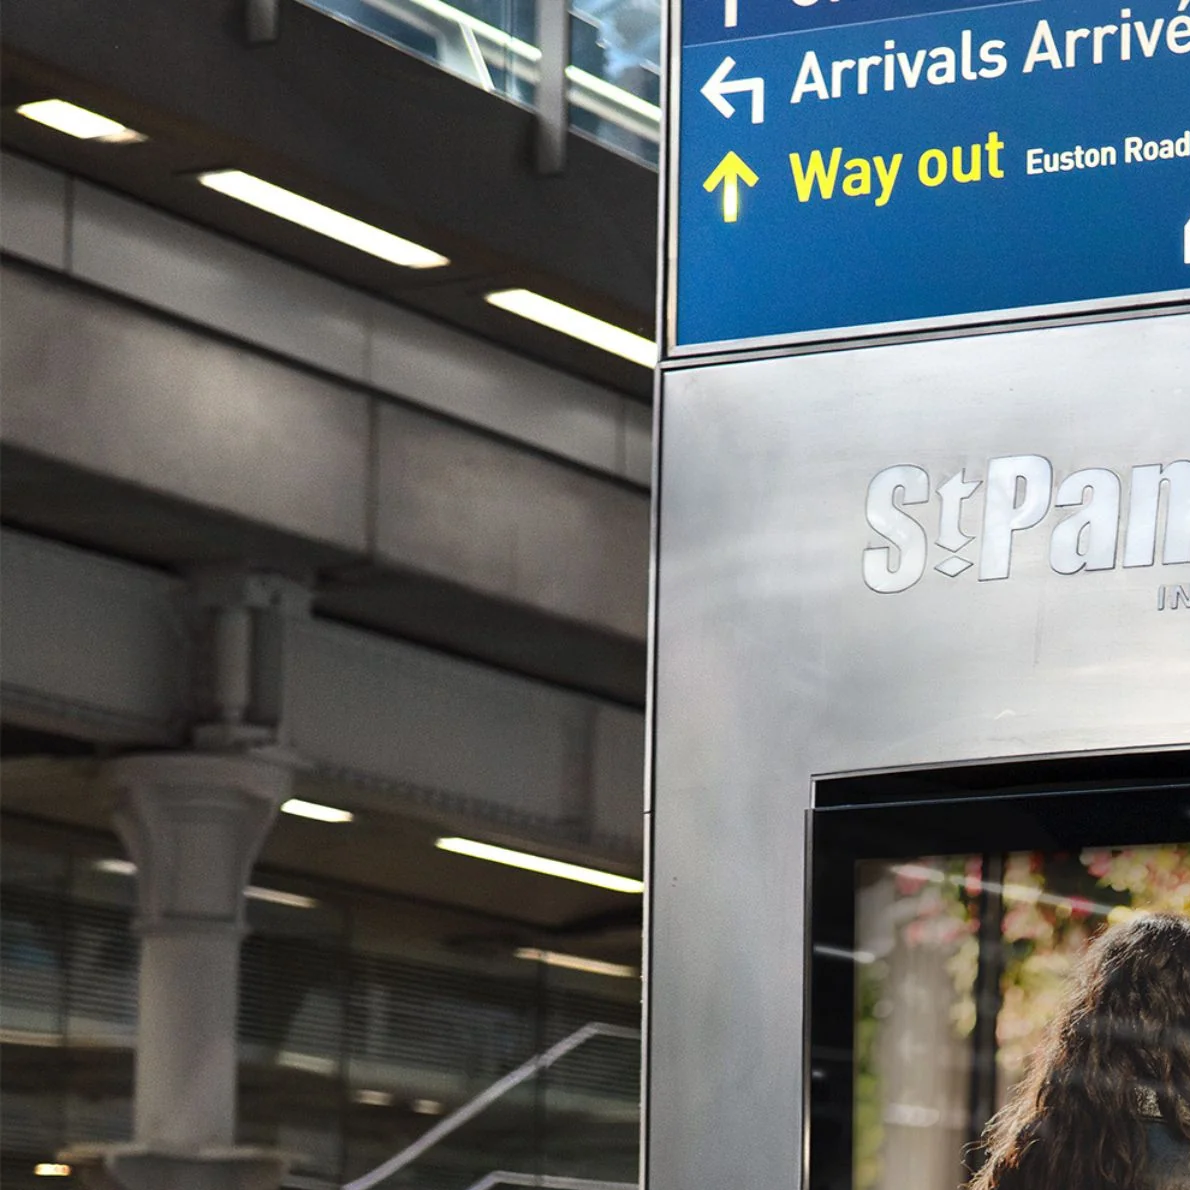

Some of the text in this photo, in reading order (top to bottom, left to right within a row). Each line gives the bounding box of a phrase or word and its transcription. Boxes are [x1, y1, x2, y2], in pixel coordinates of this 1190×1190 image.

[790, 29, 1008, 104] Arrivals
[789, 131, 1005, 207] Way out
[1025, 144, 1117, 175] Euston
